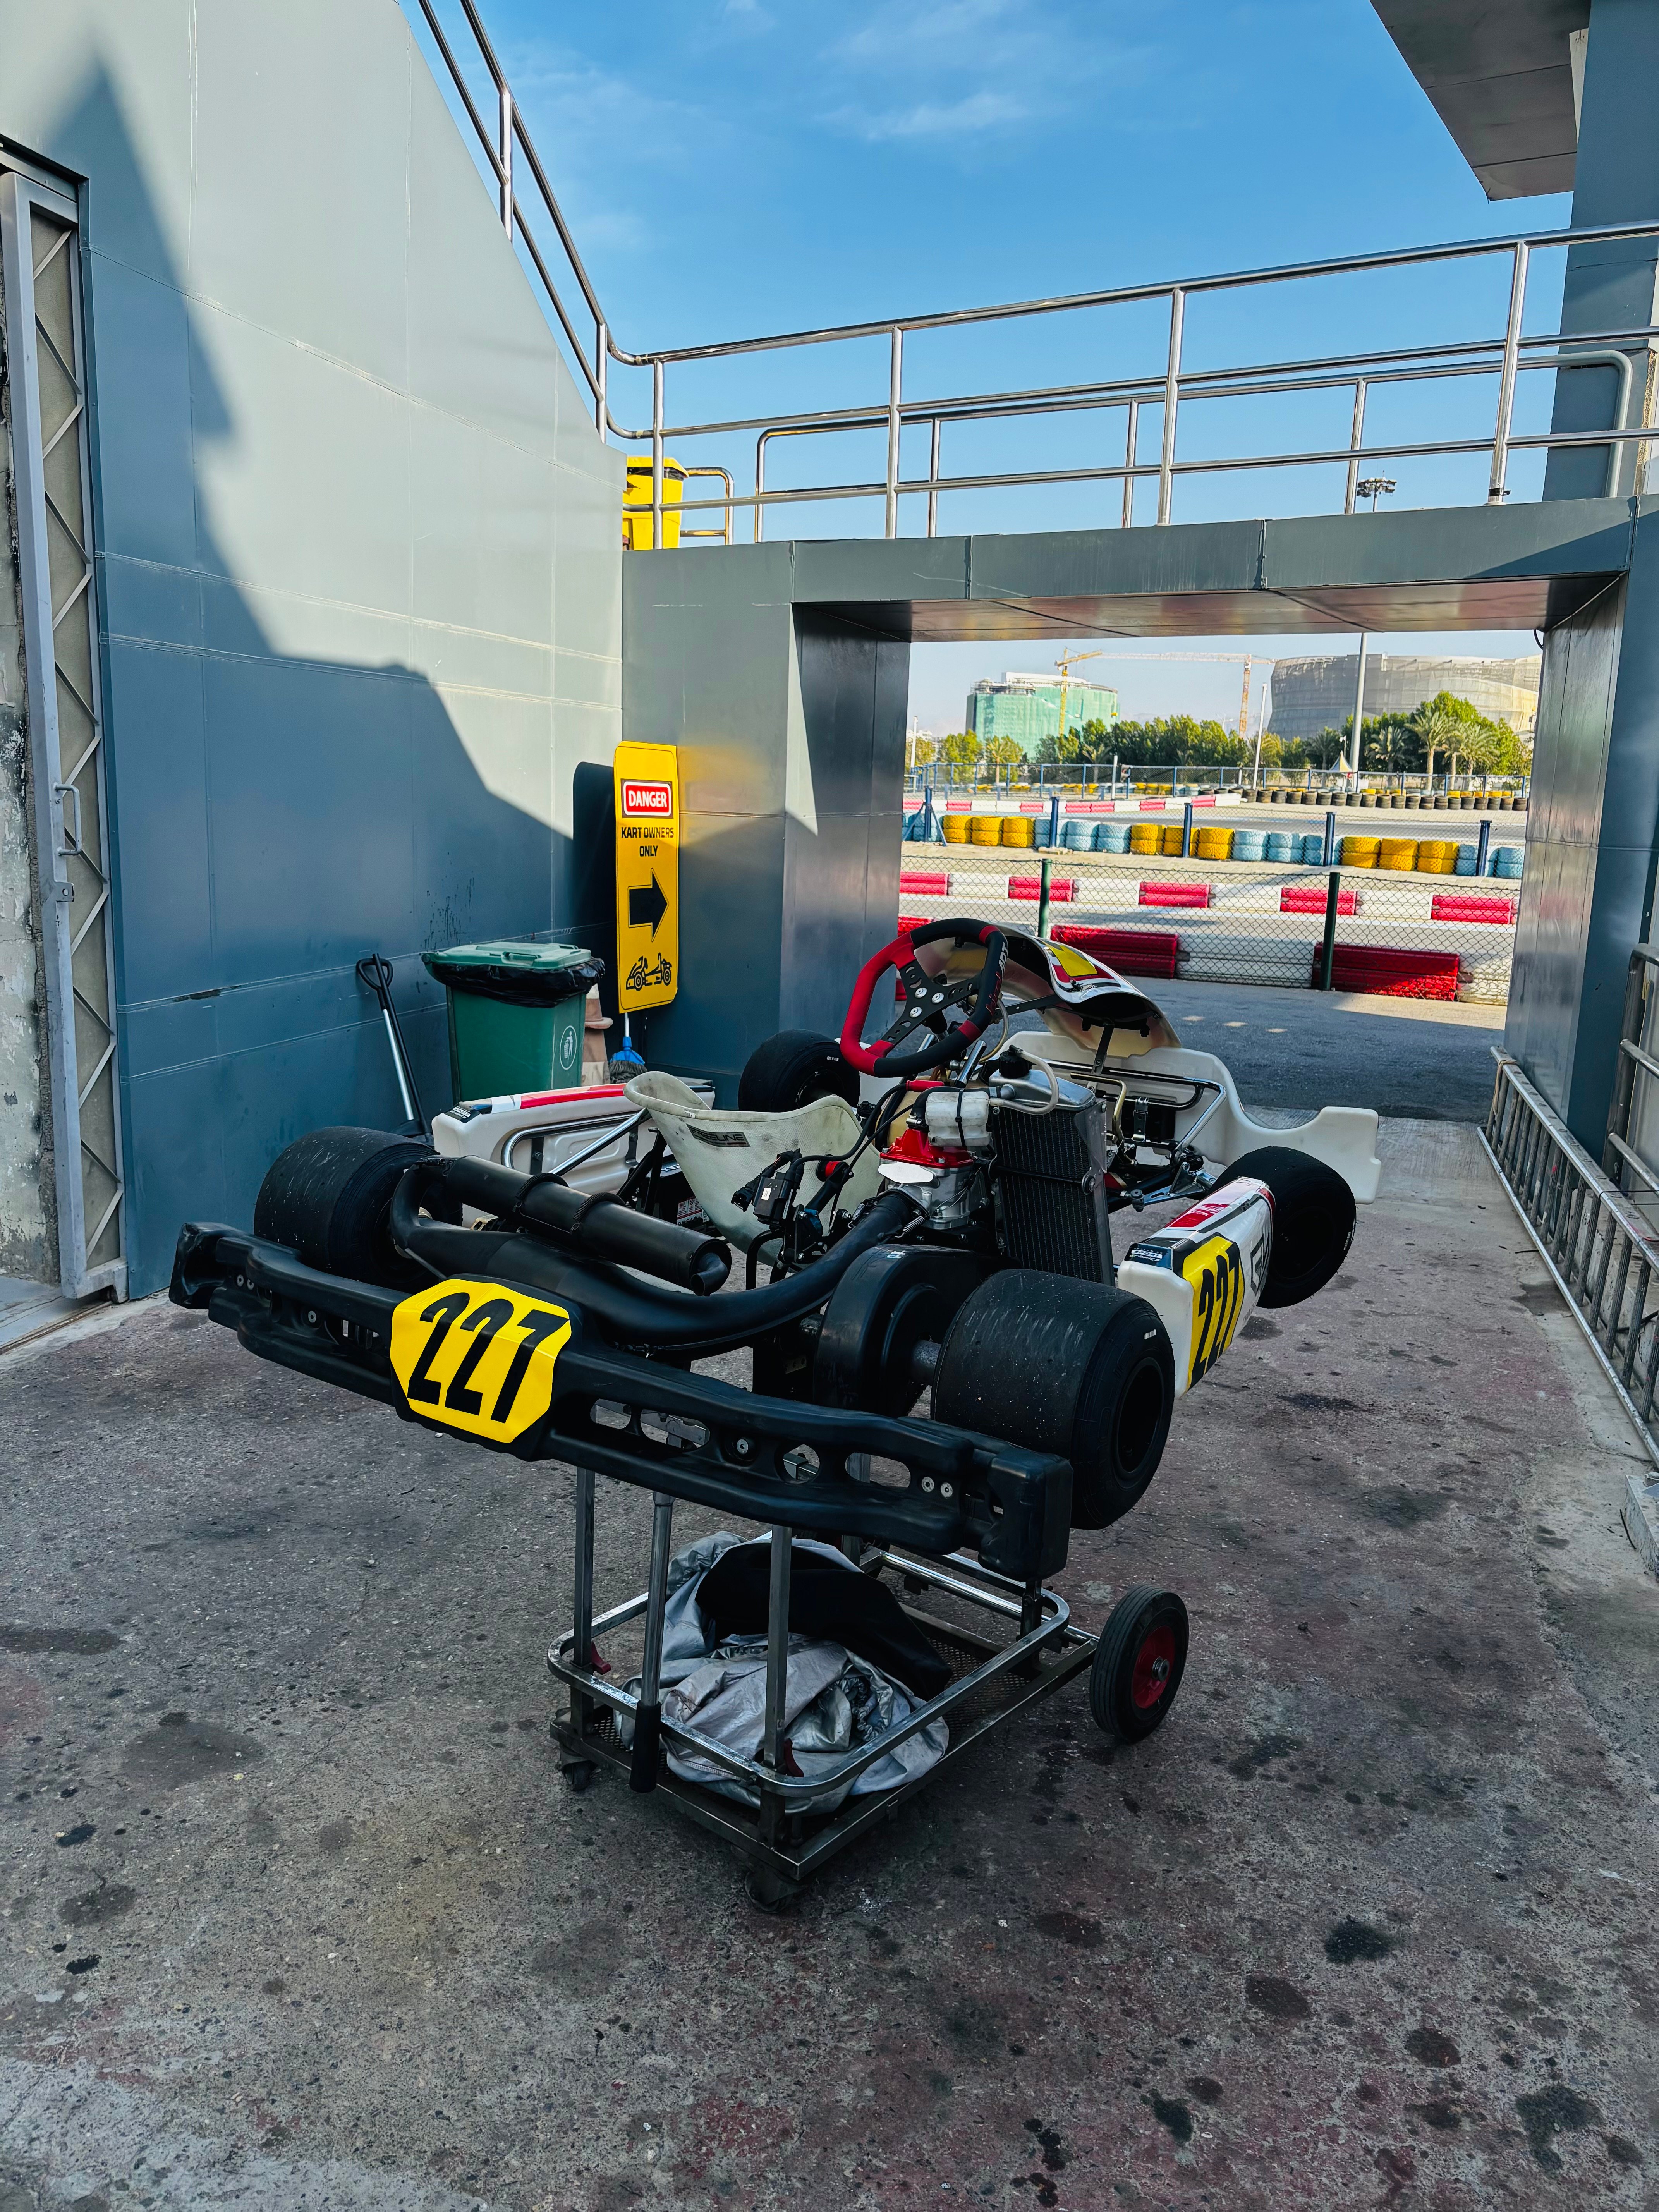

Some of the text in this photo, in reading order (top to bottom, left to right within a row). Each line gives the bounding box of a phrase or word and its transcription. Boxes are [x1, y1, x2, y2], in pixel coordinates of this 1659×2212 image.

[628, 790, 667, 807] DANGER
[621, 827, 674, 838] KART OWNERS
[639, 845, 658, 857] ONLY
[1188, 1241, 1239, 1391] 227
[407, 1292, 570, 1424] 227
